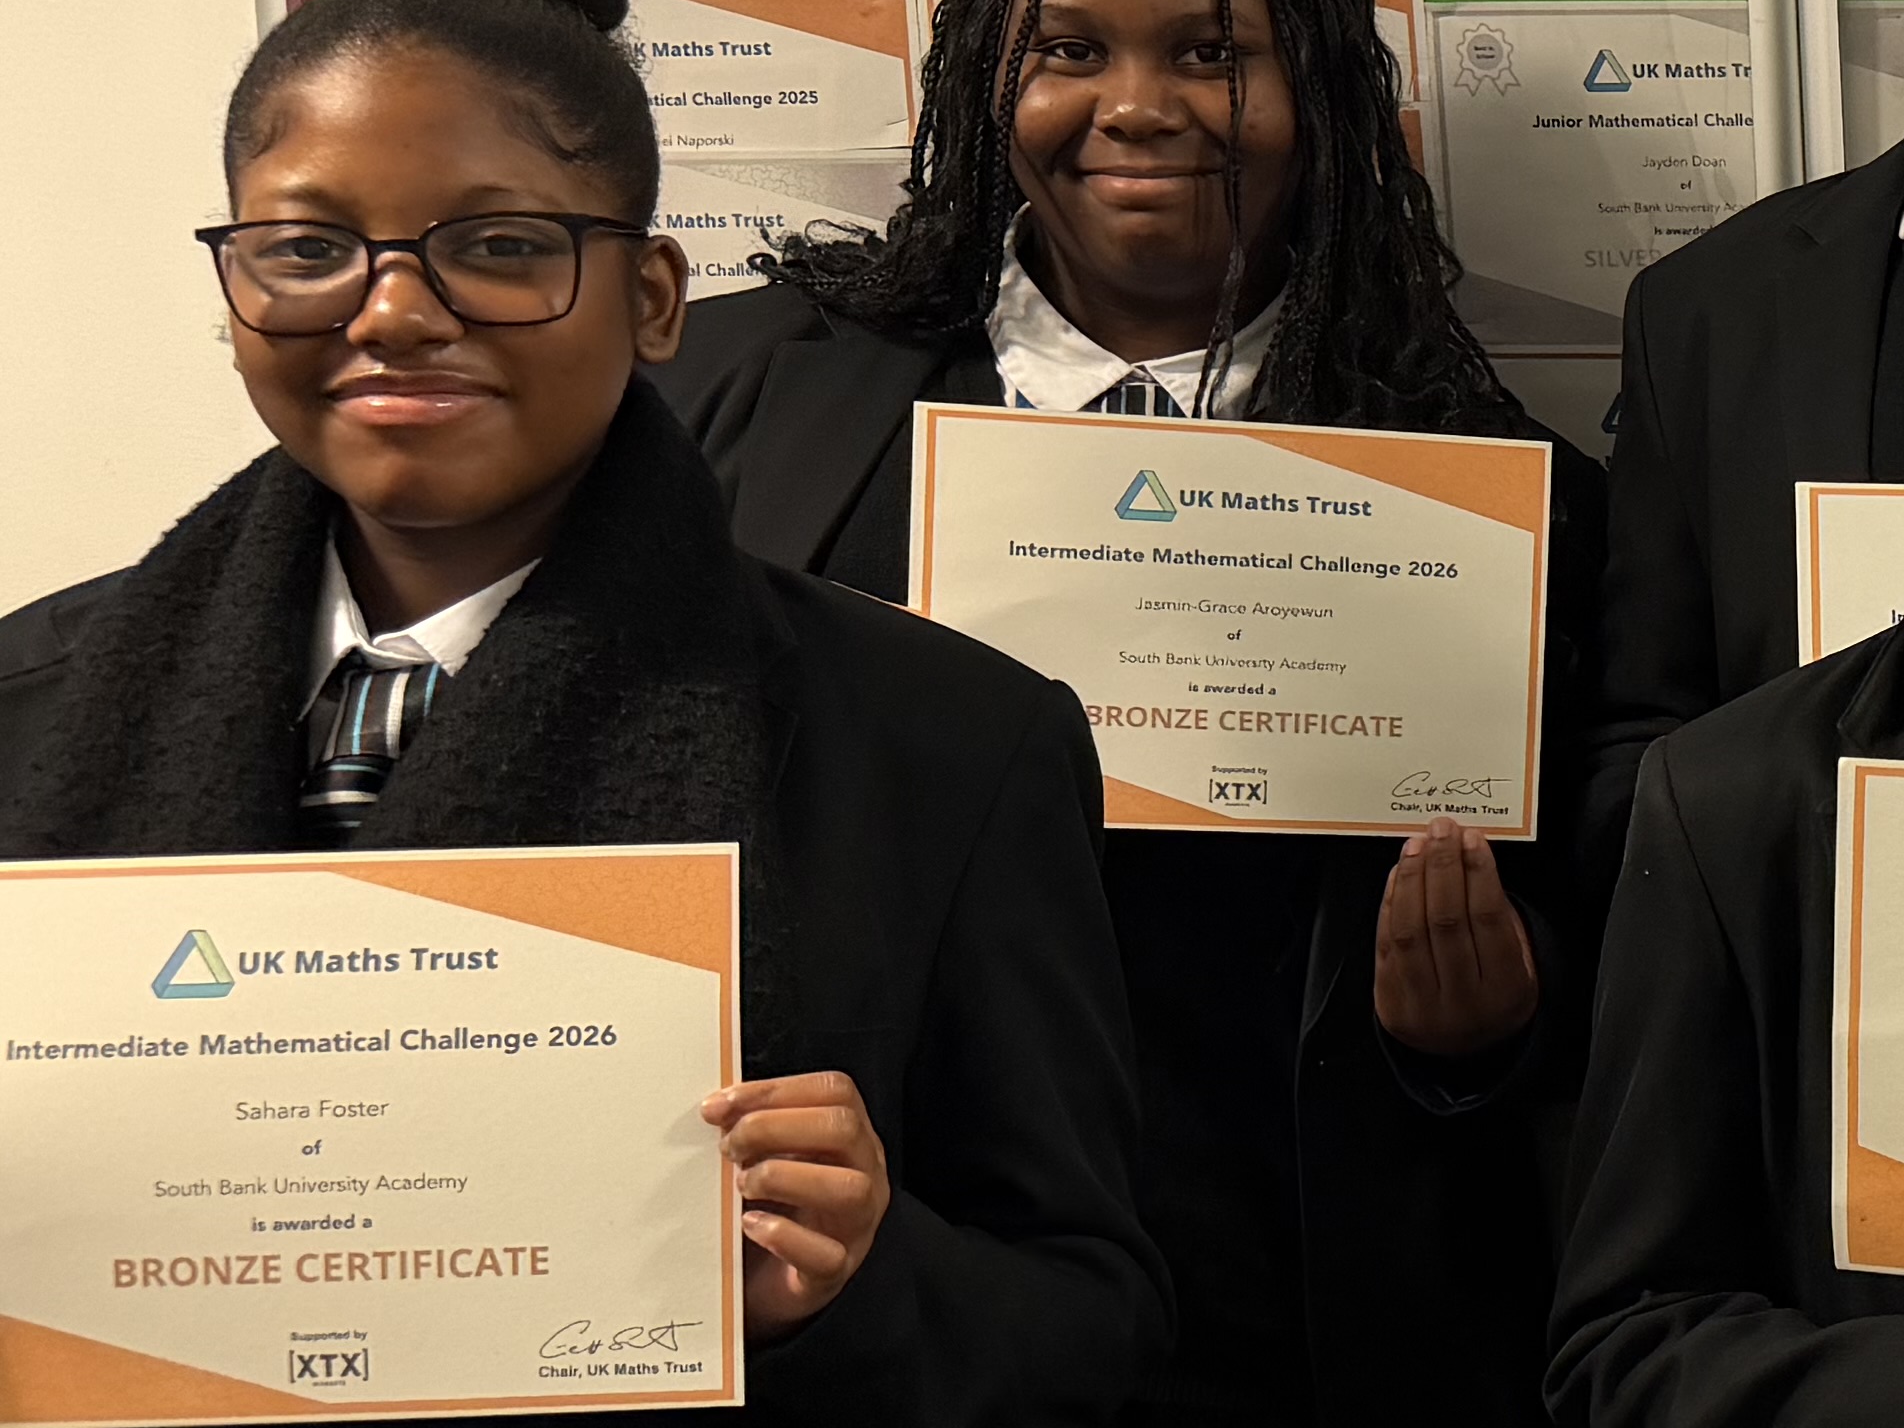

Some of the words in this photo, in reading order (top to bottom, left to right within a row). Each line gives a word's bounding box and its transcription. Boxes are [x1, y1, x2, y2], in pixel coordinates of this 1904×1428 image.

[1135, 598, 1246, 614] Jasmin-Grace
[1089, 705, 1208, 730] BRONZE
[1219, 710, 1402, 737] CERTIFICATE
[239, 951, 284, 975] UK
[295, 948, 399, 973] Maths
[410, 948, 498, 970] Trust
[7, 1035, 188, 1060] Intermediate
[199, 1029, 390, 1055] Mathematical
[400, 1027, 538, 1054] Challenge
[548, 1025, 617, 1046] 2026
[236, 1101, 310, 1120] Sahara
[319, 1100, 389, 1118] Foster
[301, 1139, 322, 1155] of
[155, 1179, 212, 1197] South
[219, 1177, 267, 1195] Bank
[274, 1176, 370, 1196] University
[375, 1172, 468, 1193] Academy
[252, 1217, 266, 1232] is
[272, 1213, 355, 1231] awarded
[362, 1218, 372, 1228] a
[114, 1254, 281, 1288] BRONZE
[296, 1246, 549, 1283] CERTIFICATE
[353, 1330, 367, 1341] by
[539, 1365, 582, 1378] Chair,
[587, 1364, 609, 1376] UK
[614, 1363, 659, 1375] Maths
[664, 1362, 702, 1373] Trust
